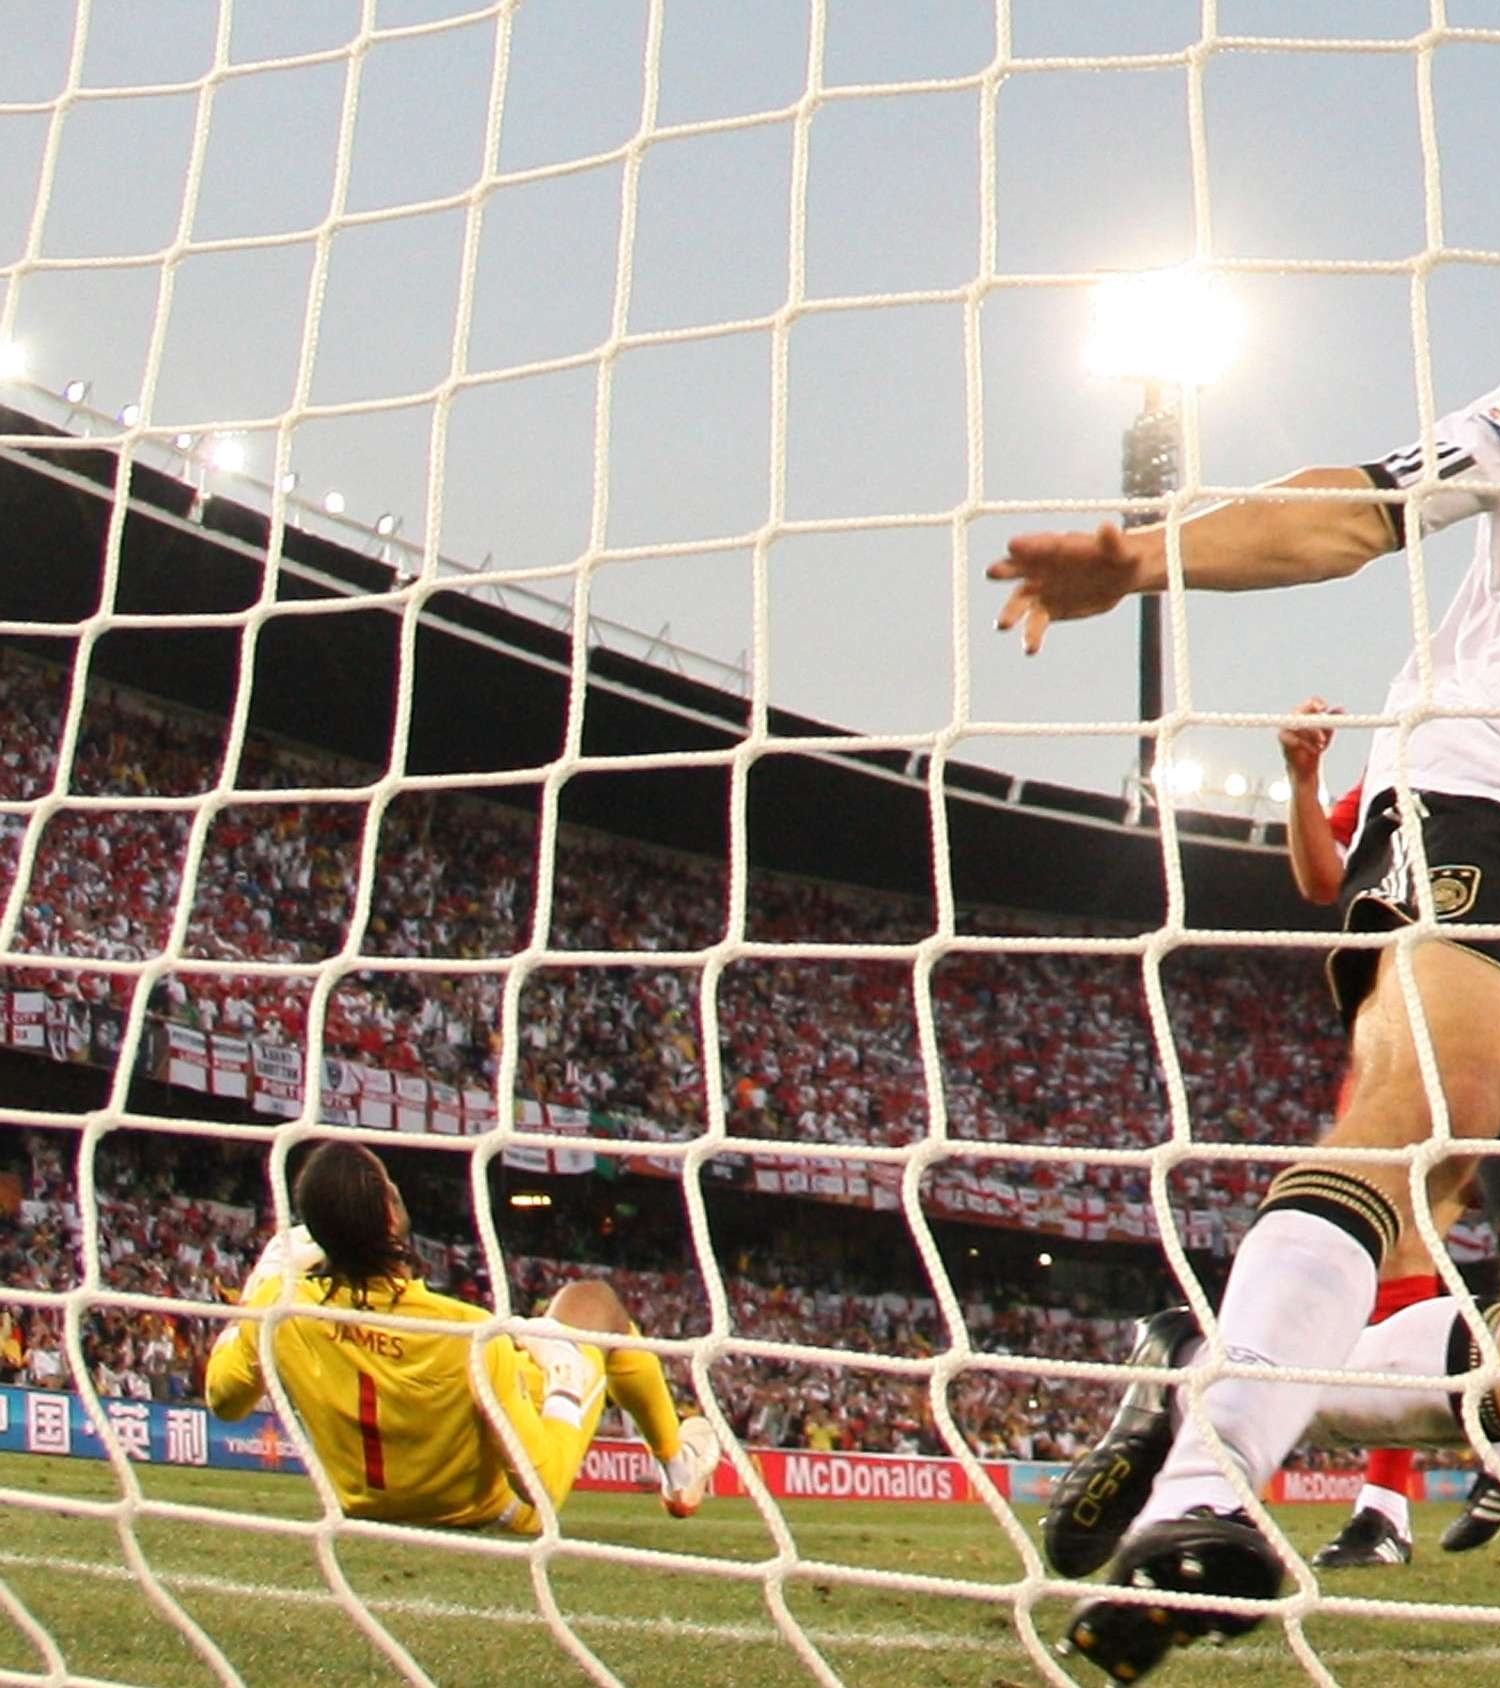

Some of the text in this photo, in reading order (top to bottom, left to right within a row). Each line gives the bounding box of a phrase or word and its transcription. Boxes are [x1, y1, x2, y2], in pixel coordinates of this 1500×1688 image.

[328, 1319, 404, 1360] JAMES
[358, 1370, 387, 1491] 1
[784, 1455, 953, 1500] McDonald's
[1283, 1470, 1366, 1500] McDonal
